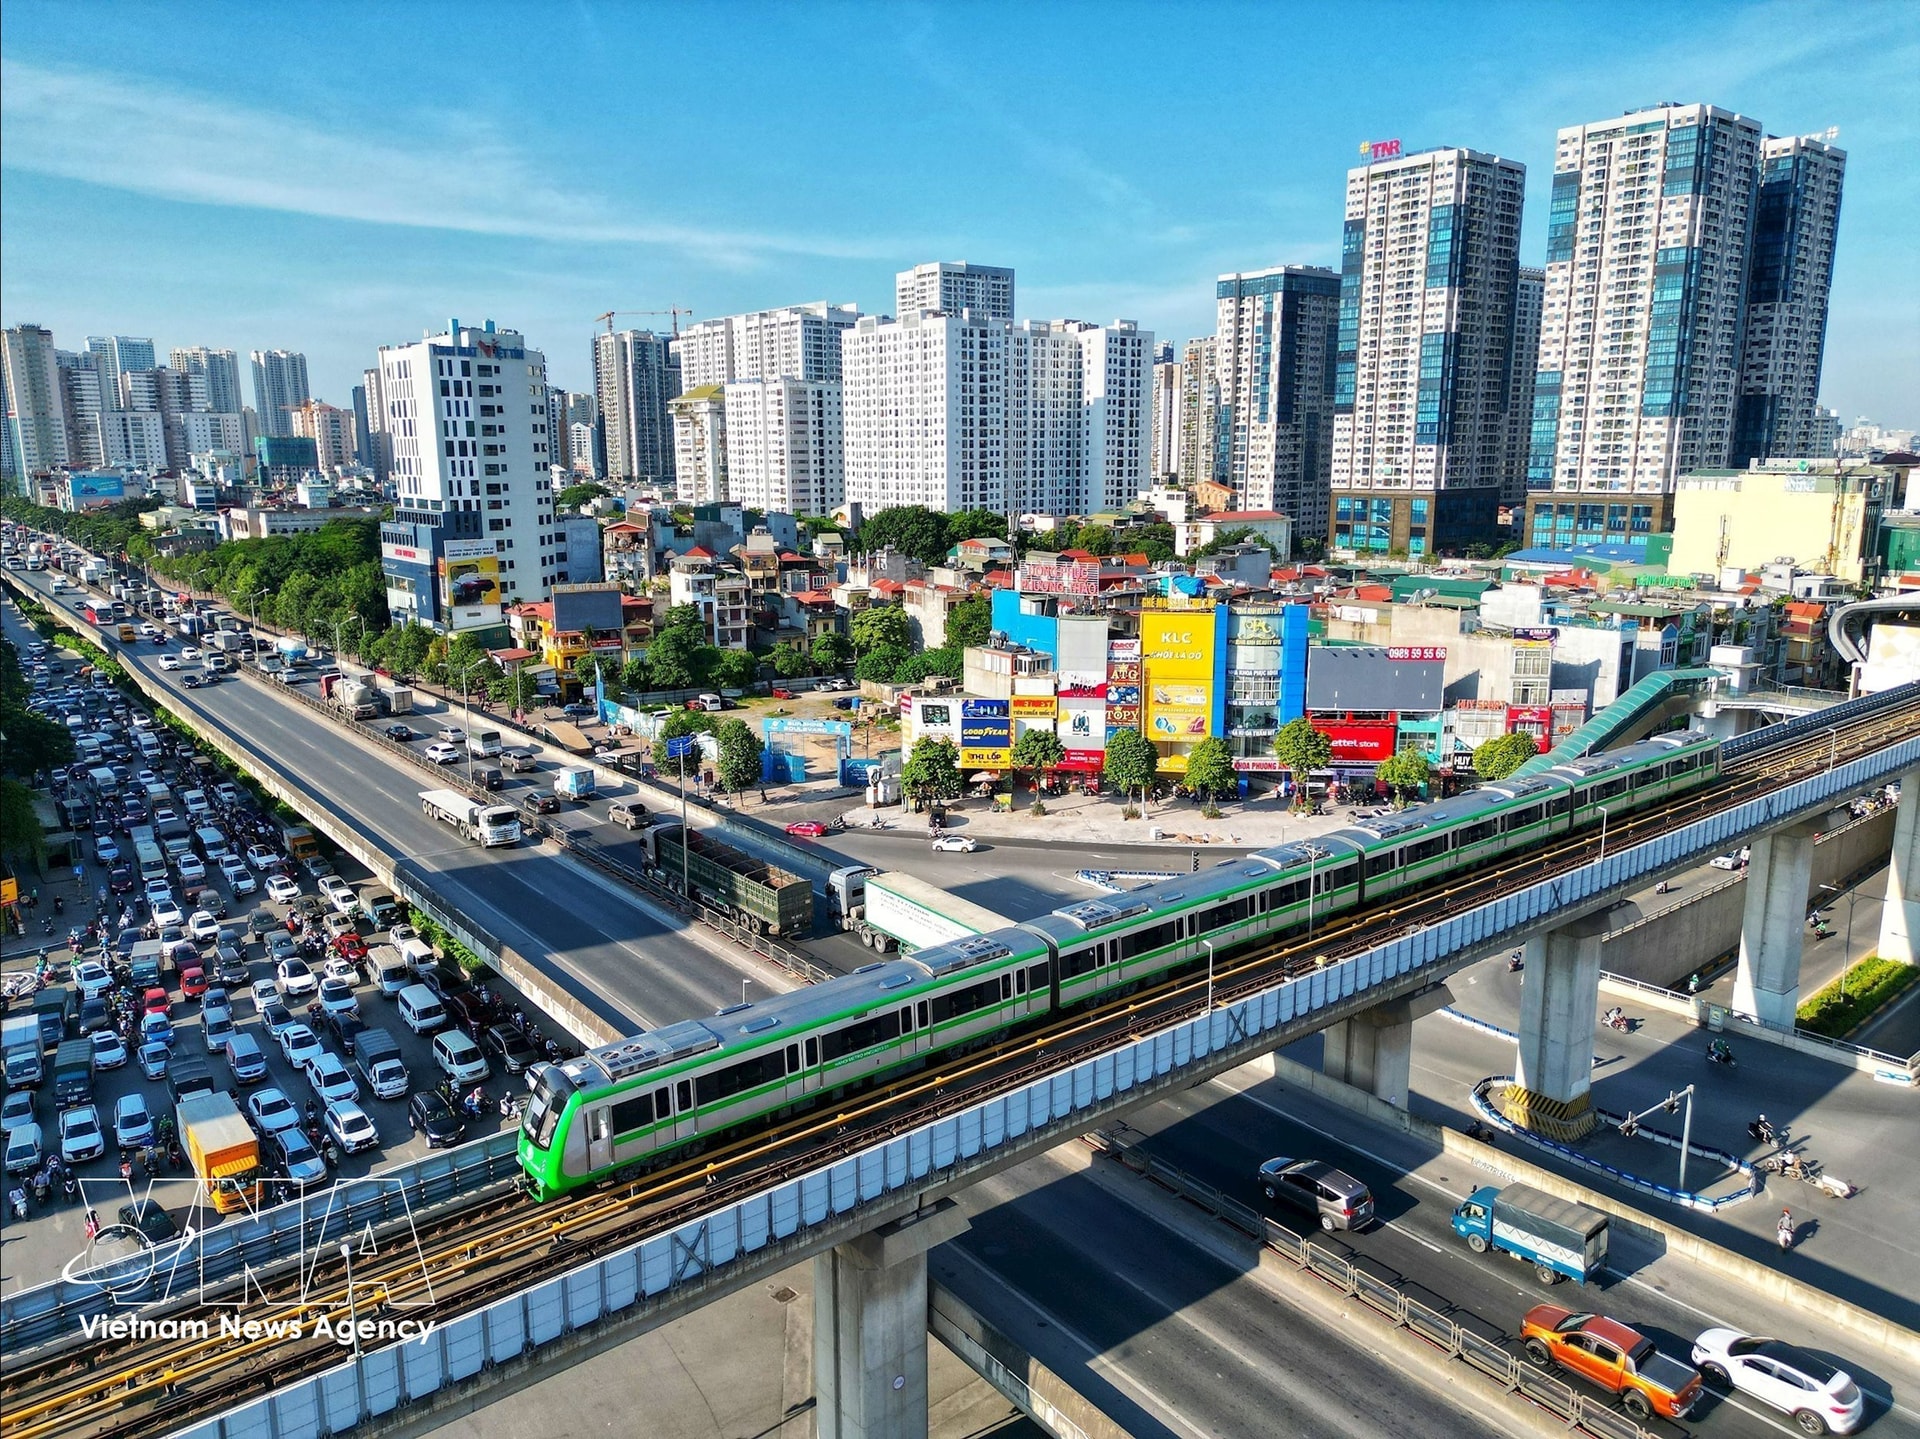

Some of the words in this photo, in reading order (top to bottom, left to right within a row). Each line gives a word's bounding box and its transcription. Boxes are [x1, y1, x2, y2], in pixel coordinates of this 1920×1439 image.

[1371, 139, 1401, 158] TNR
[1161, 632, 1192, 644] KLC
[1389, 648, 1410, 659] 0988
[1410, 648, 1422, 660] 59
[1423, 648, 1434, 660] 55
[1435, 648, 1446, 660] 66
[962, 726, 1008, 736] GOODYEAR
[1331, 739, 1358, 747] ettel
[1454, 756, 1470, 766] HUY
